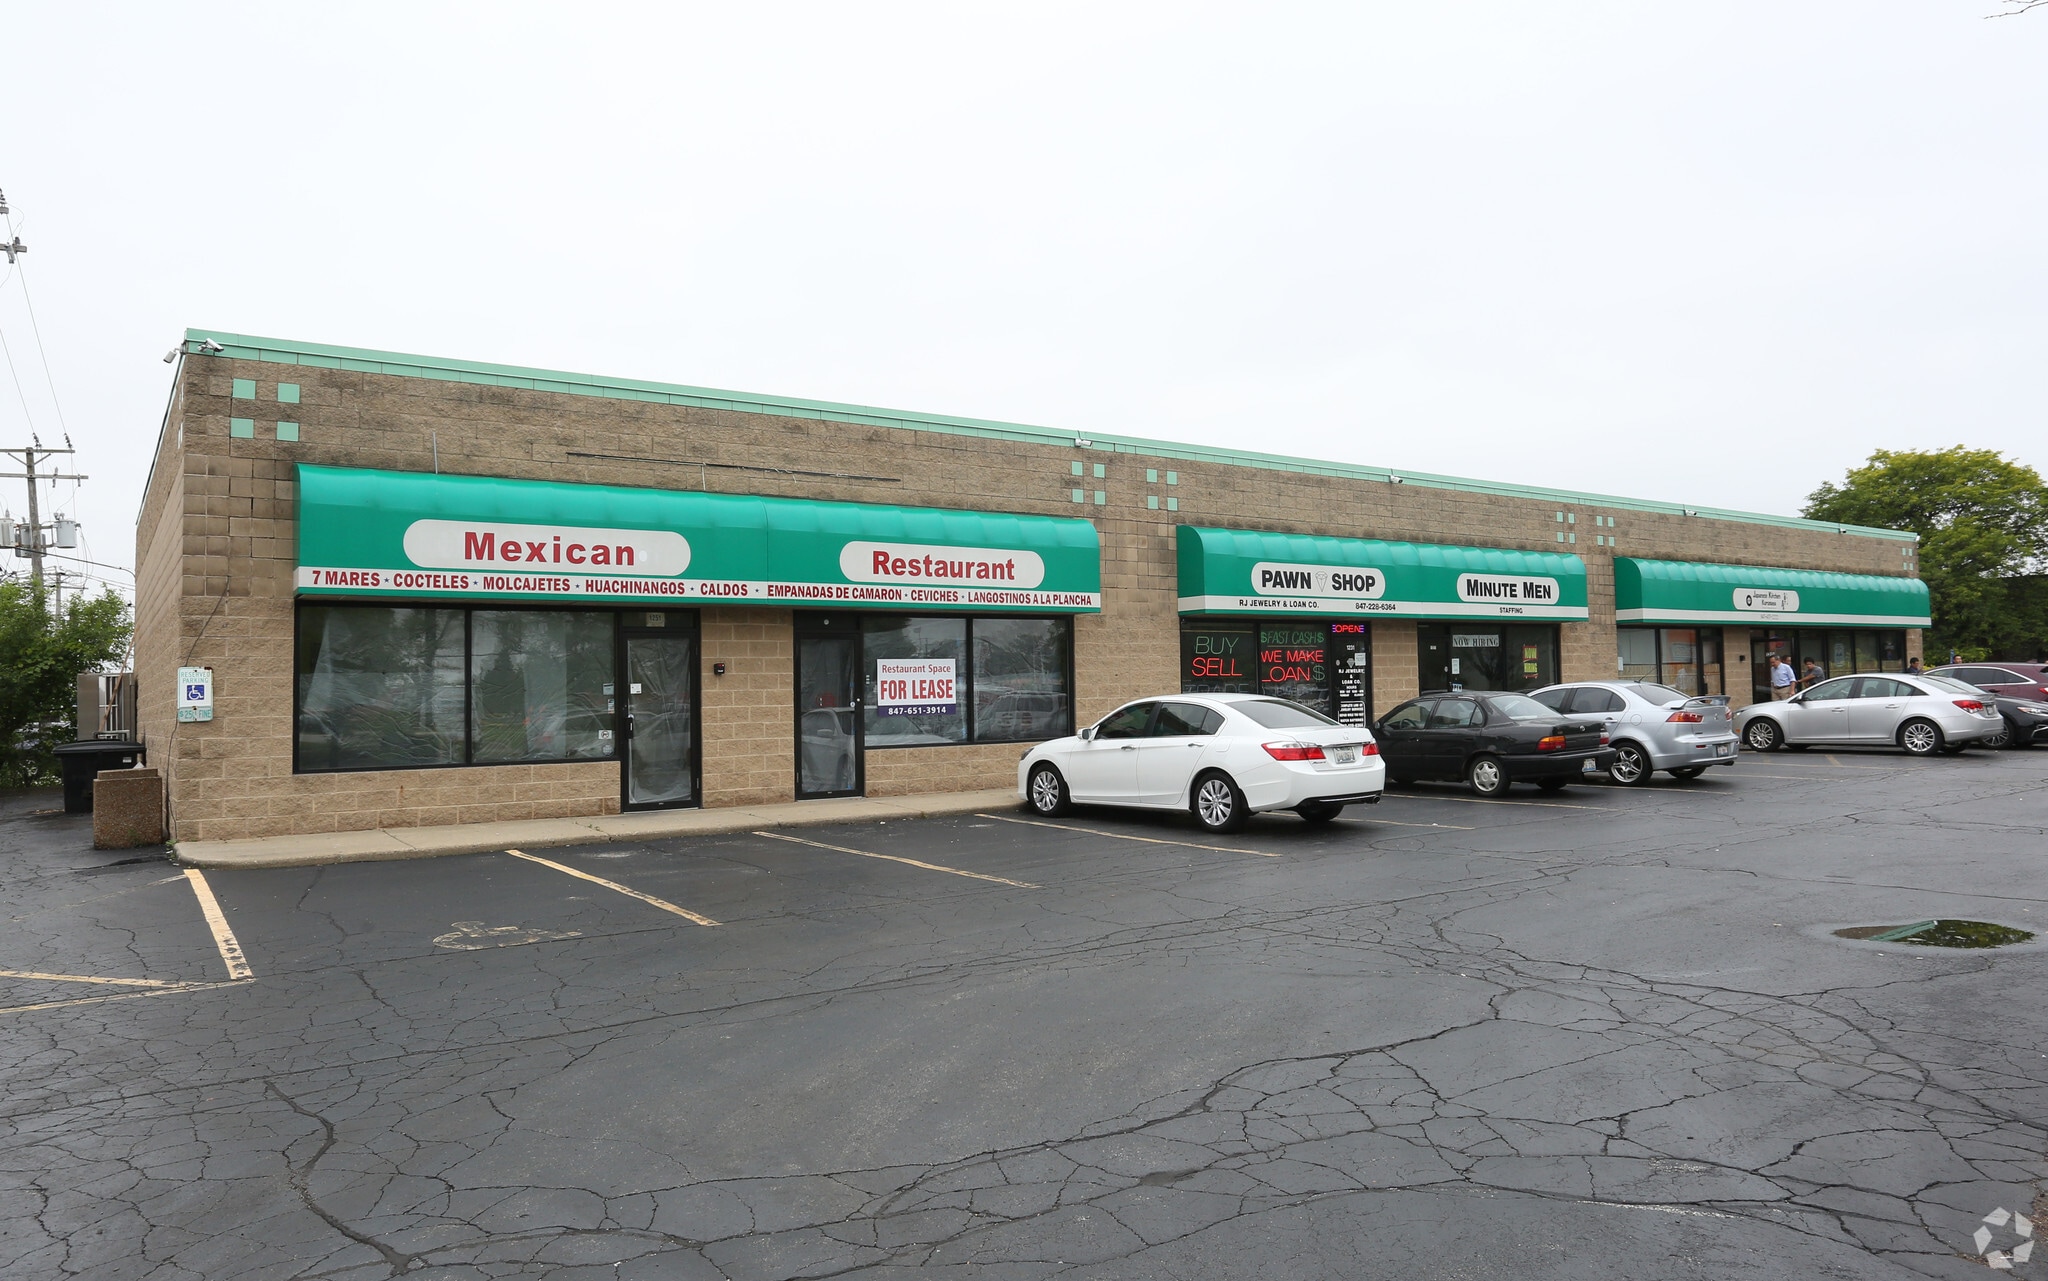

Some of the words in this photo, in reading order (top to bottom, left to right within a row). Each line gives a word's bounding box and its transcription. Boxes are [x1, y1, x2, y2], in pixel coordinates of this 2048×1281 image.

[463, 531, 635, 567] Mexican
[872, 550, 1015, 581] Restaurant
[312, 570, 321, 586] 7
[325, 570, 381, 588] MARES
[393, 573, 469, 590] COCTELES
[483, 576, 571, 593] MOLCAJETES
[585, 579, 686, 595] HUACHINANGOS
[700, 583, 748, 597] CALDOS
[767, 584, 834, 600] EMPANADAS
[835, 586, 850, 600] DE
[851, 587, 903, 601] CAMARON
[910, 589, 959, 603] CEVICHES
[967, 591, 1032, 605] LANGOSTINOS
[1032, 594, 1040, 605] A
[1040, 594, 1051, 605] LA
[1052, 594, 1092, 606] PLANCHA
[1261, 569, 1312, 590] PAWN
[1331, 573, 1376, 592] SHOP
[1466, 578, 1518, 598] MINUTE
[1522, 581, 1551, 599] MEN
[1239, 599, 1248, 608] RJ
[1250, 599, 1281, 608] JEWELRY
[1282, 600, 1288, 608] &
[1289, 600, 1305, 609] LOAN
[1306, 601, 1320, 609] CO.
[1355, 602, 1396, 611] 847-228-6364
[1335, 624, 1361, 633] OPEN
[1195, 635, 1240, 655] BUY
[1453, 637, 1469, 647] NOW
[1472, 637, 1499, 647] HIRING
[1261, 650, 1283, 663] WE
[1286, 650, 1325, 663] MAKE
[882, 664, 926, 674] Restaurant
[928, 664, 951, 675] Space
[1191, 656, 1243, 677] SELL
[880, 679, 907, 700] FOR
[911, 678, 954, 700] LEASE
[199, 709, 212, 719] FINE
[888, 706, 947, 716] 847-651-3914
